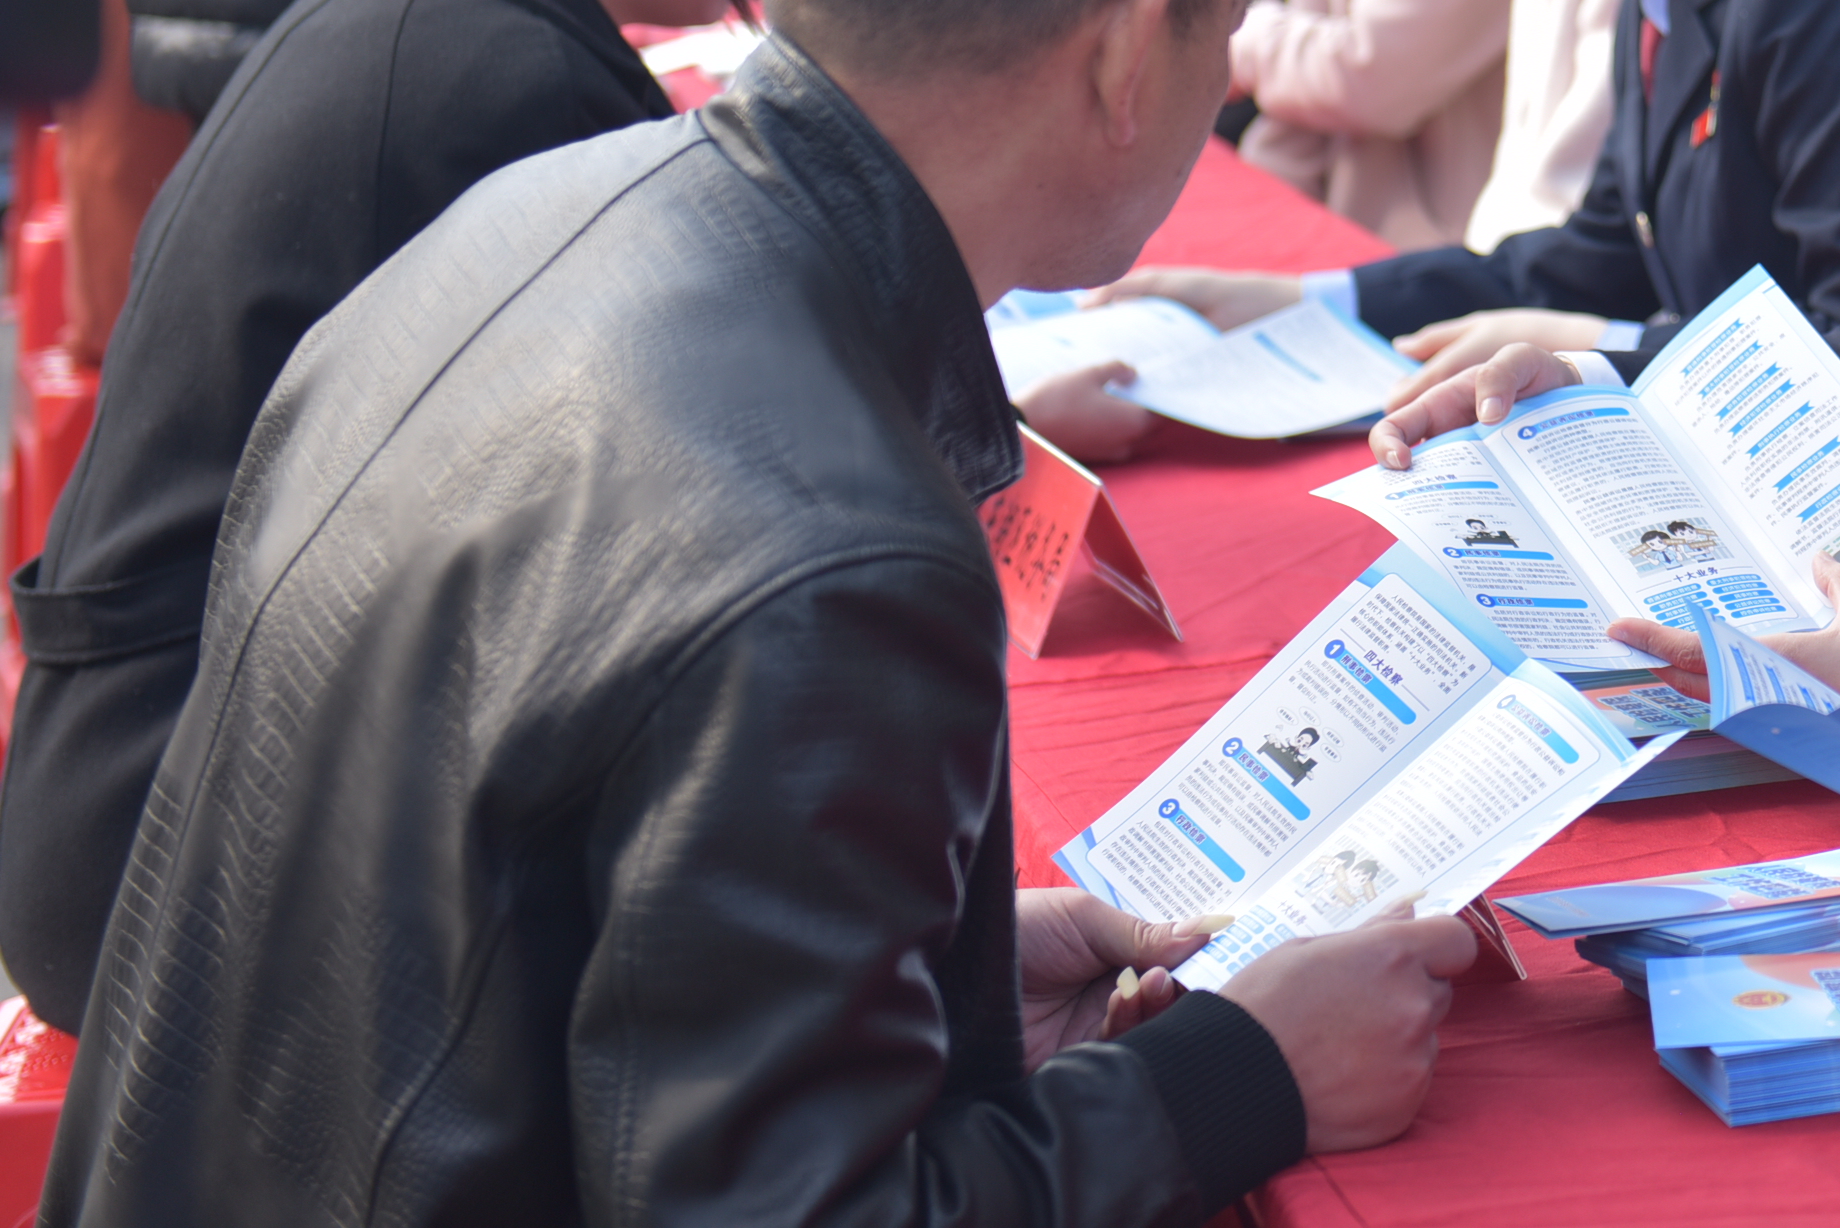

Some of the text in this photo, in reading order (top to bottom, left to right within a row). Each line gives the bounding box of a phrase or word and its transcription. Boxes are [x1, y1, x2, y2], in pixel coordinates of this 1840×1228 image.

[1522, 409, 1595, 437] 4 公益诉讼检察
[1756, 410, 1802, 449] 刑事执行检察业务
[1788, 449, 1825, 479] 民事检察业务
[1449, 549, 1459, 557] 2
[1673, 567, 1719, 583] 十大业务
[1481, 596, 1534, 606] 3 行政检察
[1734, 591, 1759, 599] 民事检察
[1734, 598, 1771, 609] 公益诉讼检察
[1348, 614, 1393, 654] 履行法律监督职责。
[1495, 622, 1606, 631] 调解书损害国家利益、社会公共利益的，行
[1503, 629, 1608, 638] 判中审判人员的违法行为或行政执行活
[1519, 643, 1600, 651] 权的，检察院都可以进行监督。
[1329, 643, 1374, 684] 1 刑事检察
[1361, 648, 1405, 687] 四大检察
[1226, 740, 1270, 782] 2 民事检察
[1163, 801, 1207, 845] 3 行政检察
[1108, 839, 1192, 921] 存在违法情形的，行政机关违法行使职权
[1117, 832, 1205, 918] 政审判中审判人员的违法行为或行政执行活
